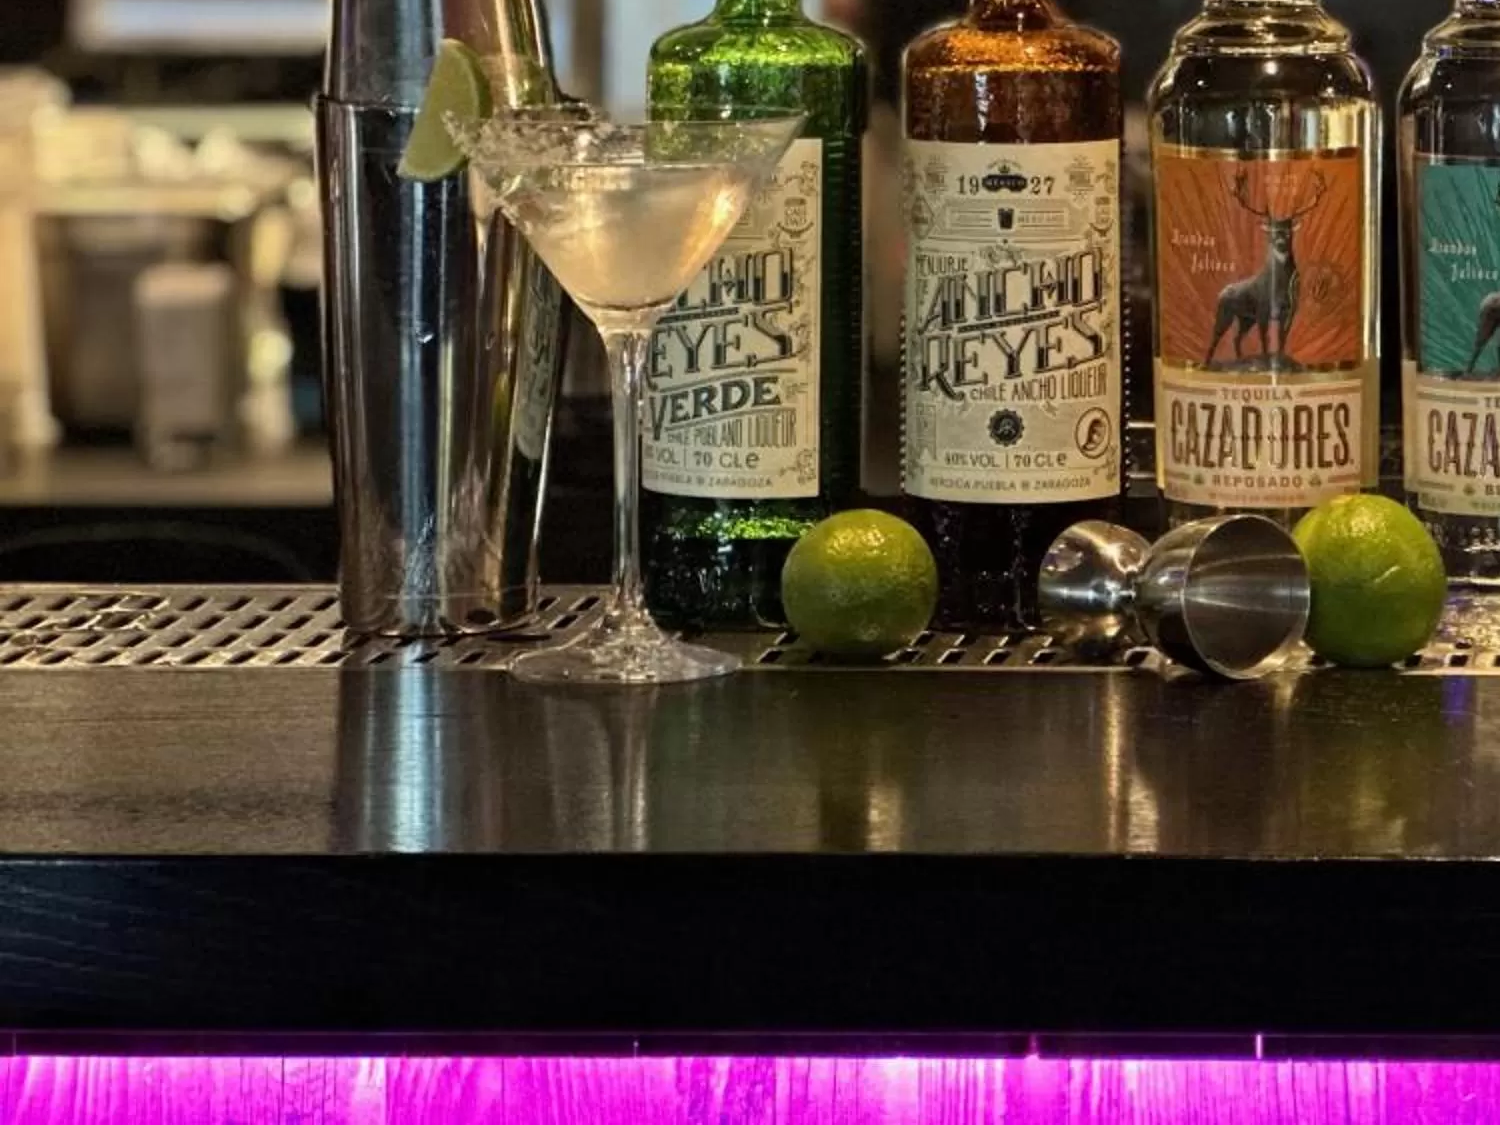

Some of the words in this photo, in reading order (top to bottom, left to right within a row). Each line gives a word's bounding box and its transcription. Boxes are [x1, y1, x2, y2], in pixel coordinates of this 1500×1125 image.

[956, 176, 980, 195] 19
[1031, 176, 1055, 195] 27
[917, 249, 1103, 335] ANCHO
[648, 305, 798, 389] EYES
[915, 299, 1106, 401] REYES
[969, 384, 1007, 402] CHILE
[1011, 374, 1057, 401] ANCHO
[1060, 364, 1107, 400] LIQUEUR
[1222, 387, 1293, 403] TEQUILA
[649, 375, 782, 442] VERDE
[1171, 399, 1350, 470] CAZADORES
[693, 450, 713, 468] 70
[1014, 453, 1031, 467] 70
[1212, 475, 1303, 488] REPOSADO
